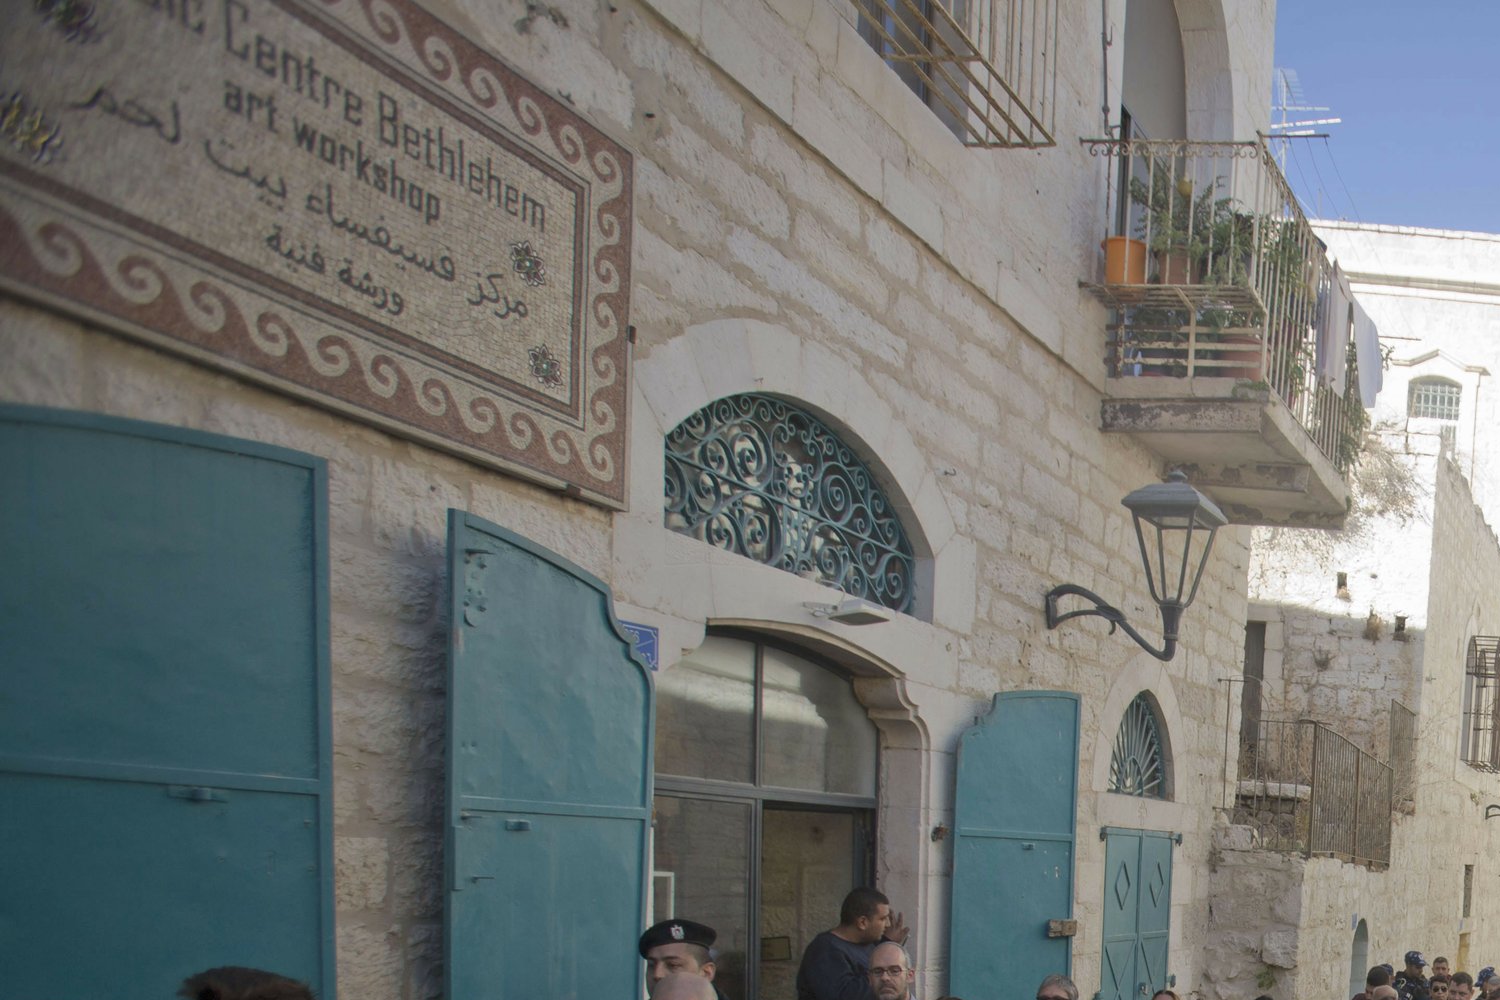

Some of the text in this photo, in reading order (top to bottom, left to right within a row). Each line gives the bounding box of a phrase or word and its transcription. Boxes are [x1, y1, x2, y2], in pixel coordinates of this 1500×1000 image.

[223, 79, 441, 224] art workshop
[224, 0, 547, 233] Centre Bethlehem
[203, 135, 288, 212] بيت
[306, 183, 456, 280] فسيفساء
[338, 256, 405, 317] ورشة
[468, 268, 528, 319] مركز
